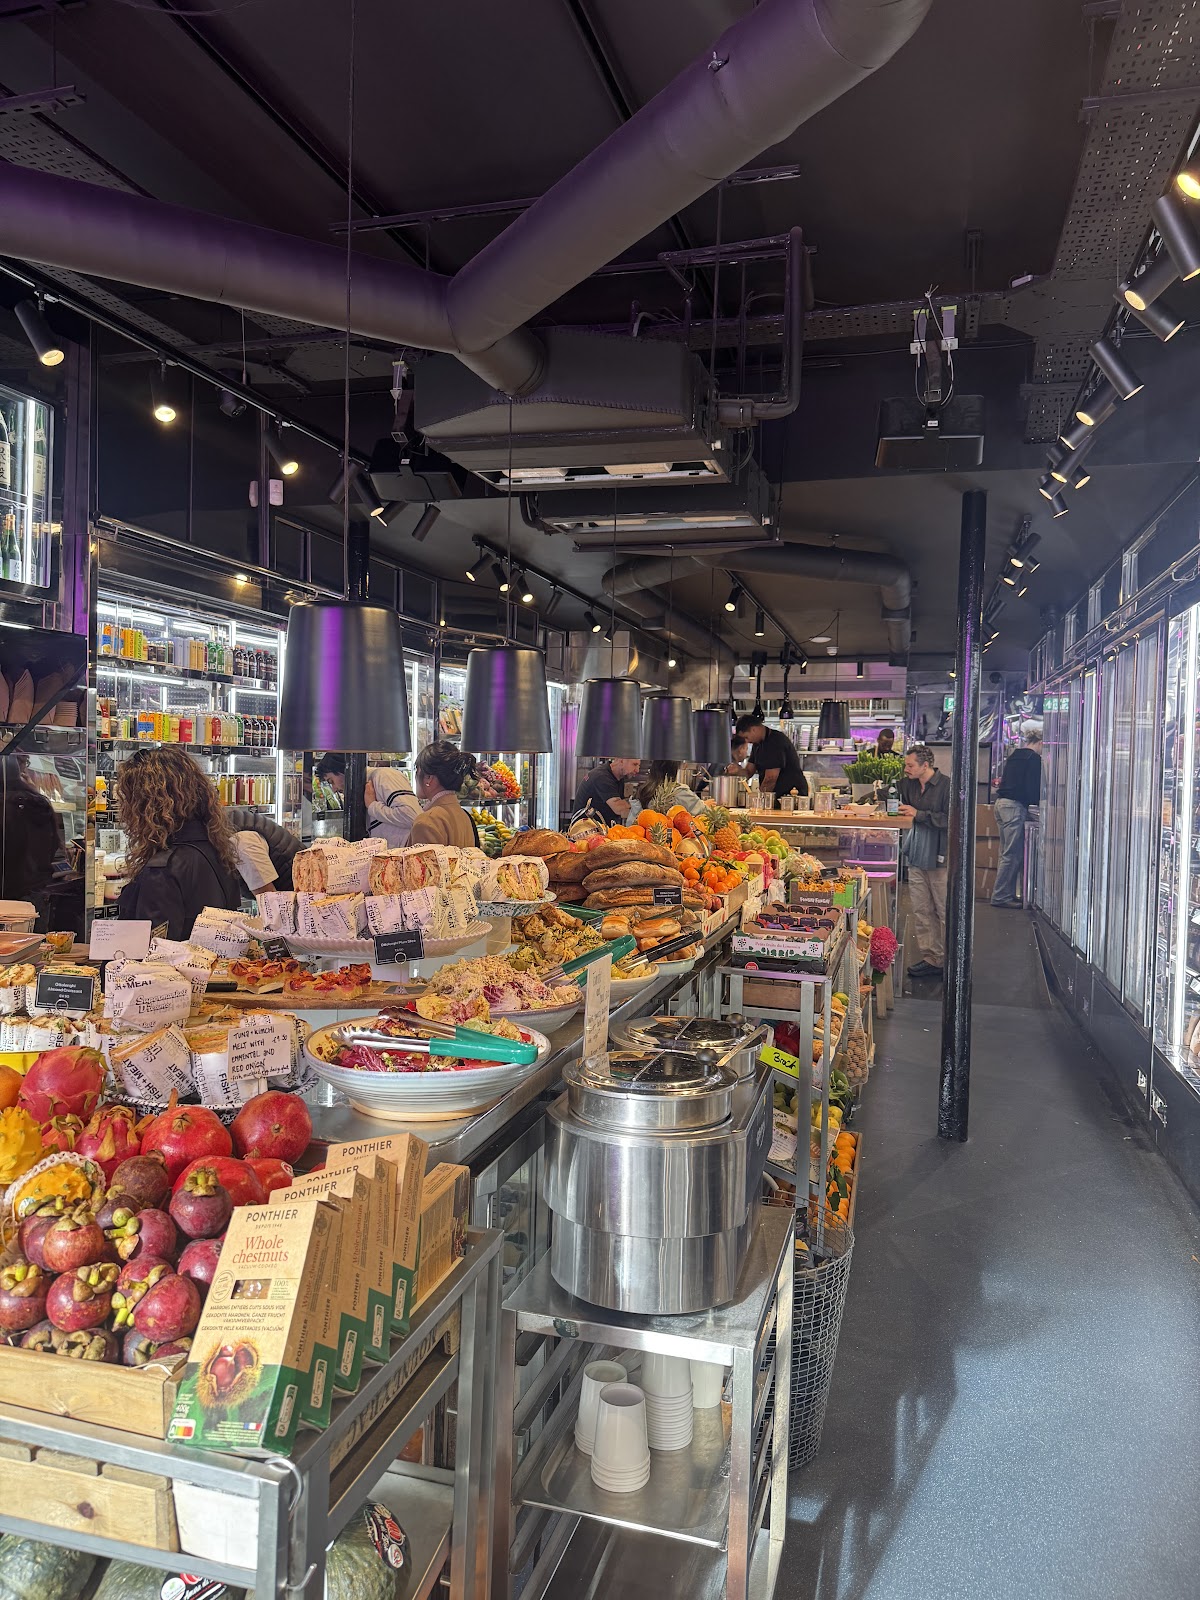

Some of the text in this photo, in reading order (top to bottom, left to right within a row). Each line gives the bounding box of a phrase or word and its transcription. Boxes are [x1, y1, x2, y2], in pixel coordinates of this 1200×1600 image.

[122, 1058, 144, 1081] MEAT
[231, 1064, 244, 1074] RED
[145, 1082, 163, 1100] FISH
[218, 1072, 231, 1094] FISH
[342, 1139, 393, 1157] PONTHIER
[284, 1180, 338, 1202] PONTHIER
[245, 1208, 299, 1223] PONTHIER
[245, 1234, 285, 1251] Whole
[232, 1248, 290, 1265] chestnuts
[352, 1272, 361, 1311] PONTHIER
[322, 1298, 332, 1340] PONTHIER
[296, 1318, 309, 1363] PONTHIER
